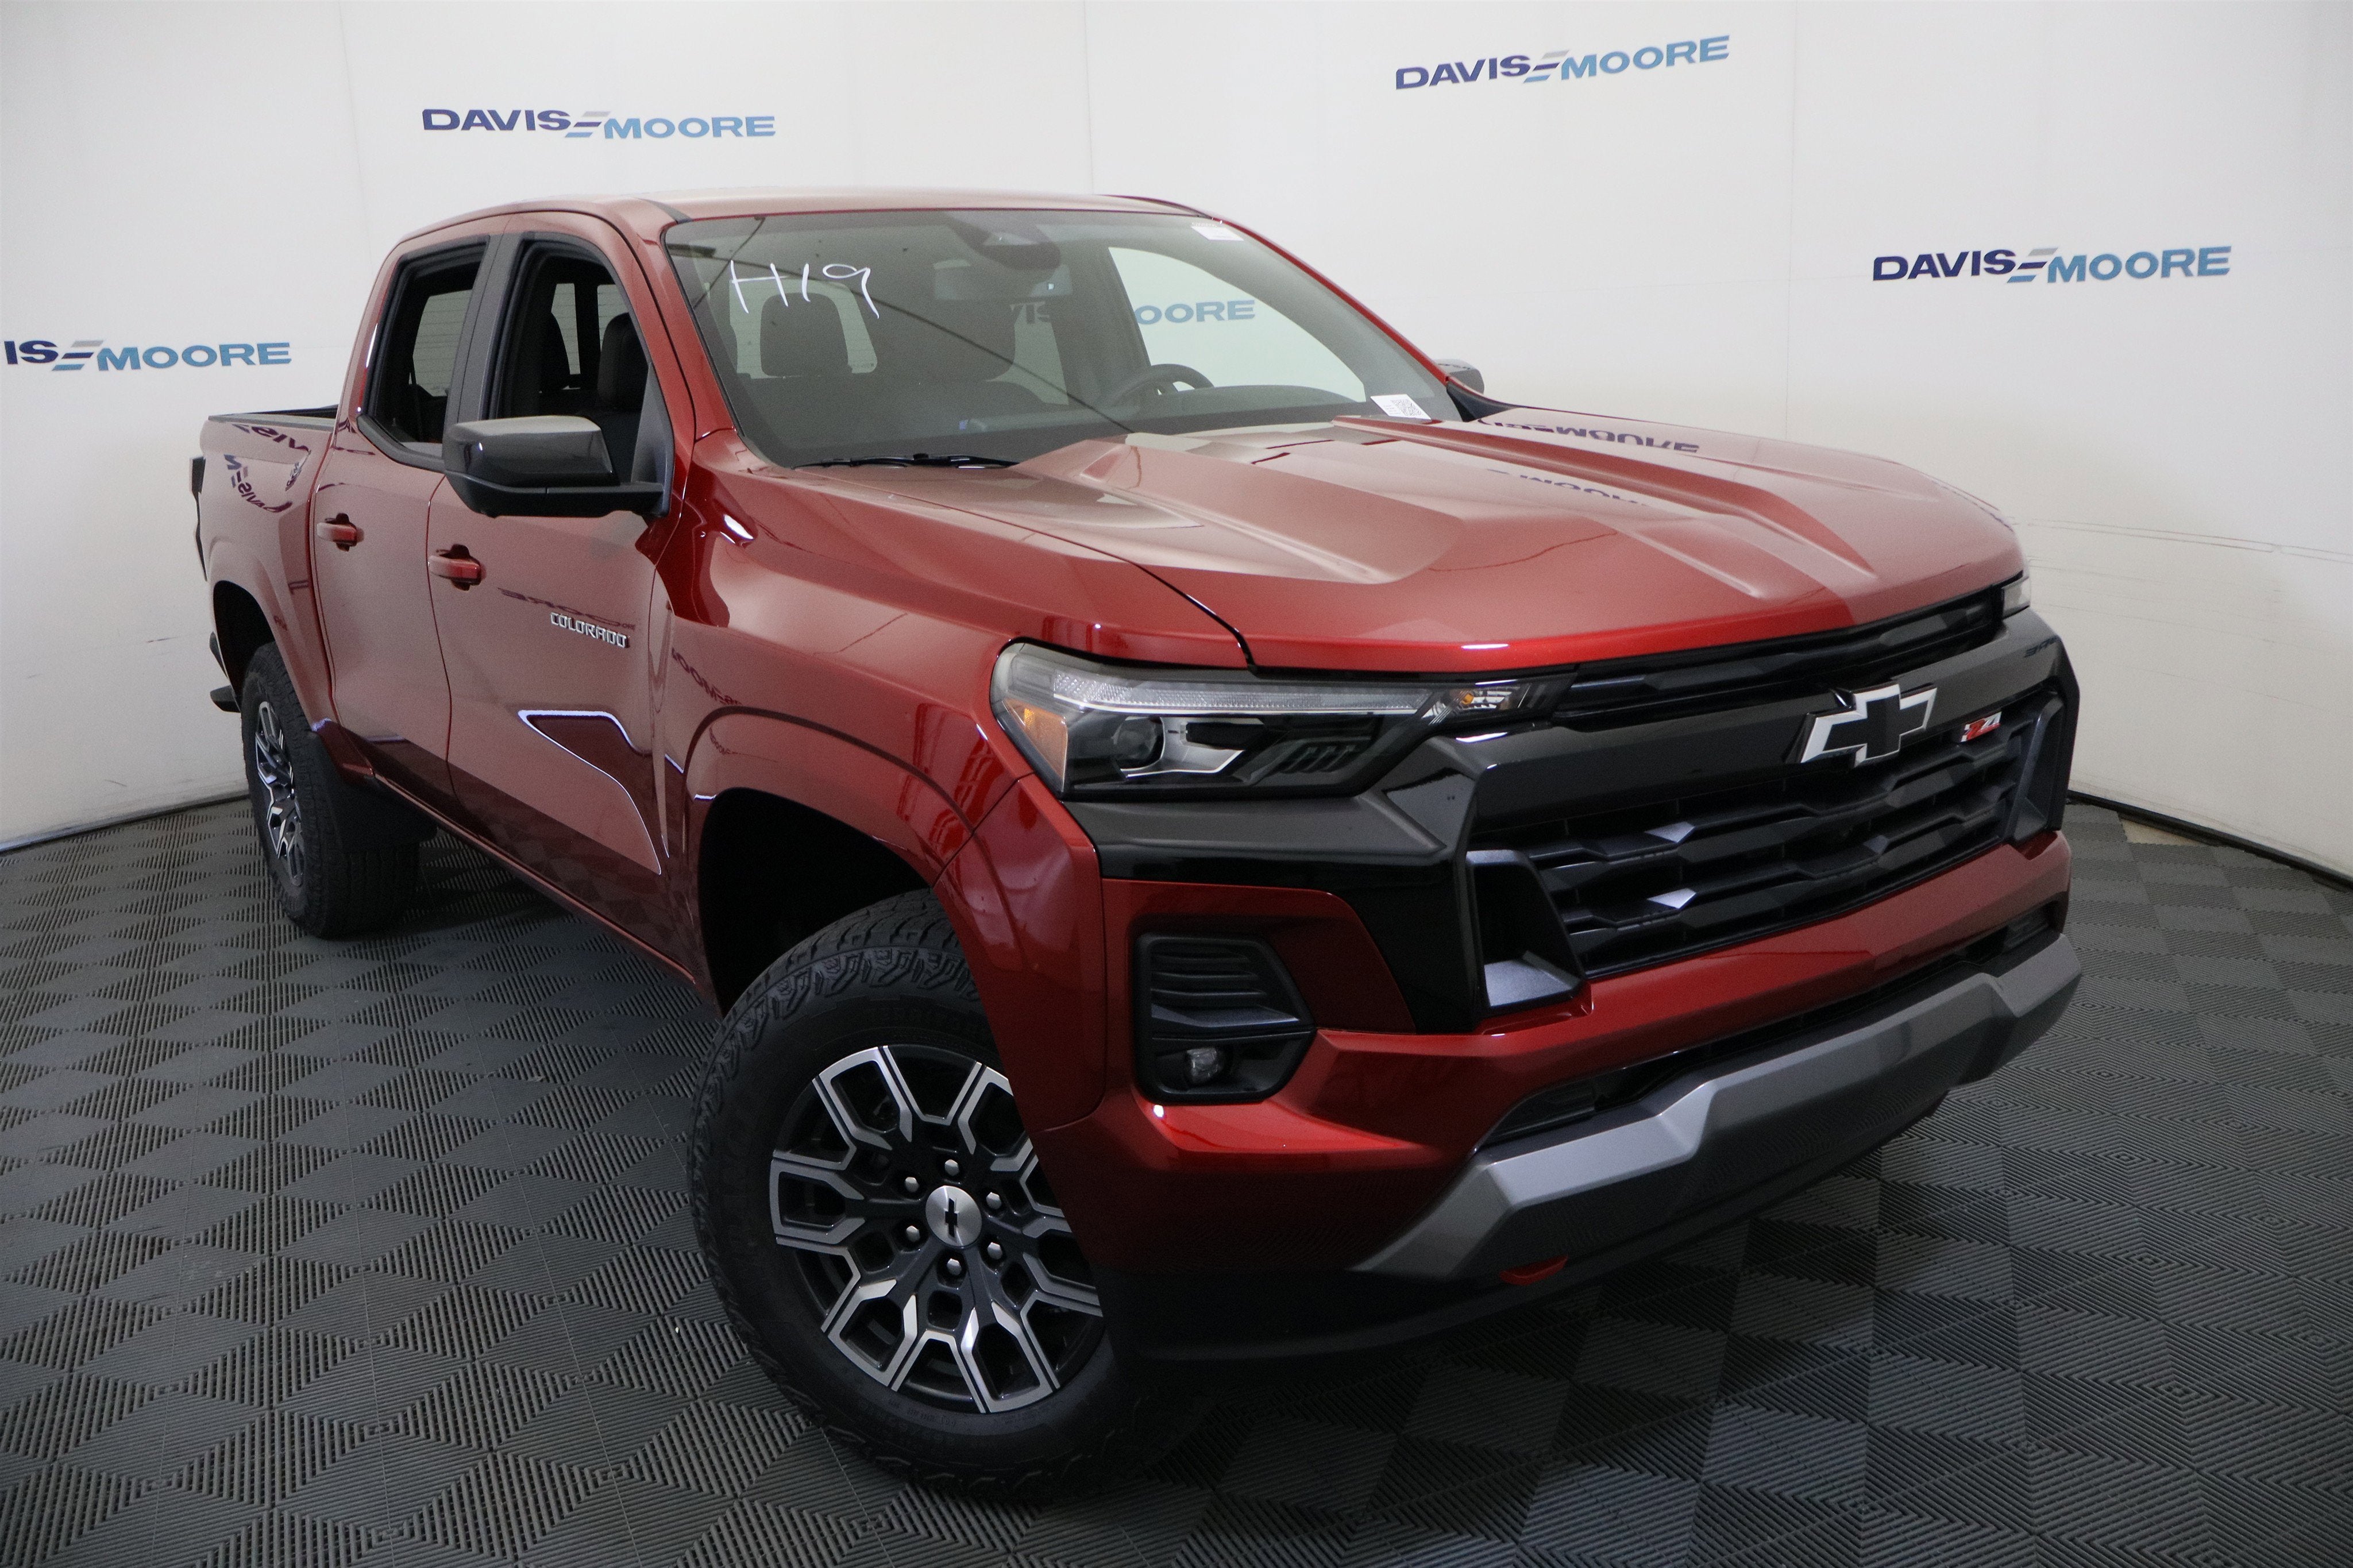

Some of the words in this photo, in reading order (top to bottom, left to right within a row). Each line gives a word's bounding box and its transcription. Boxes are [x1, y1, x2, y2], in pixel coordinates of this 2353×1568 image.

[1395, 54, 1532, 90] DAVIS
[1560, 34, 1730, 81] MOORE
[422, 108, 571, 132] DAVIS
[603, 115, 776, 140] MOORE
[1872, 248, 2016, 281] DAVIS
[2047, 245, 2232, 284] MOORE
[730, 259, 880, 319] H19
[96, 342, 292, 372] MOORE
[549, 611, 628, 649] COLORADO
